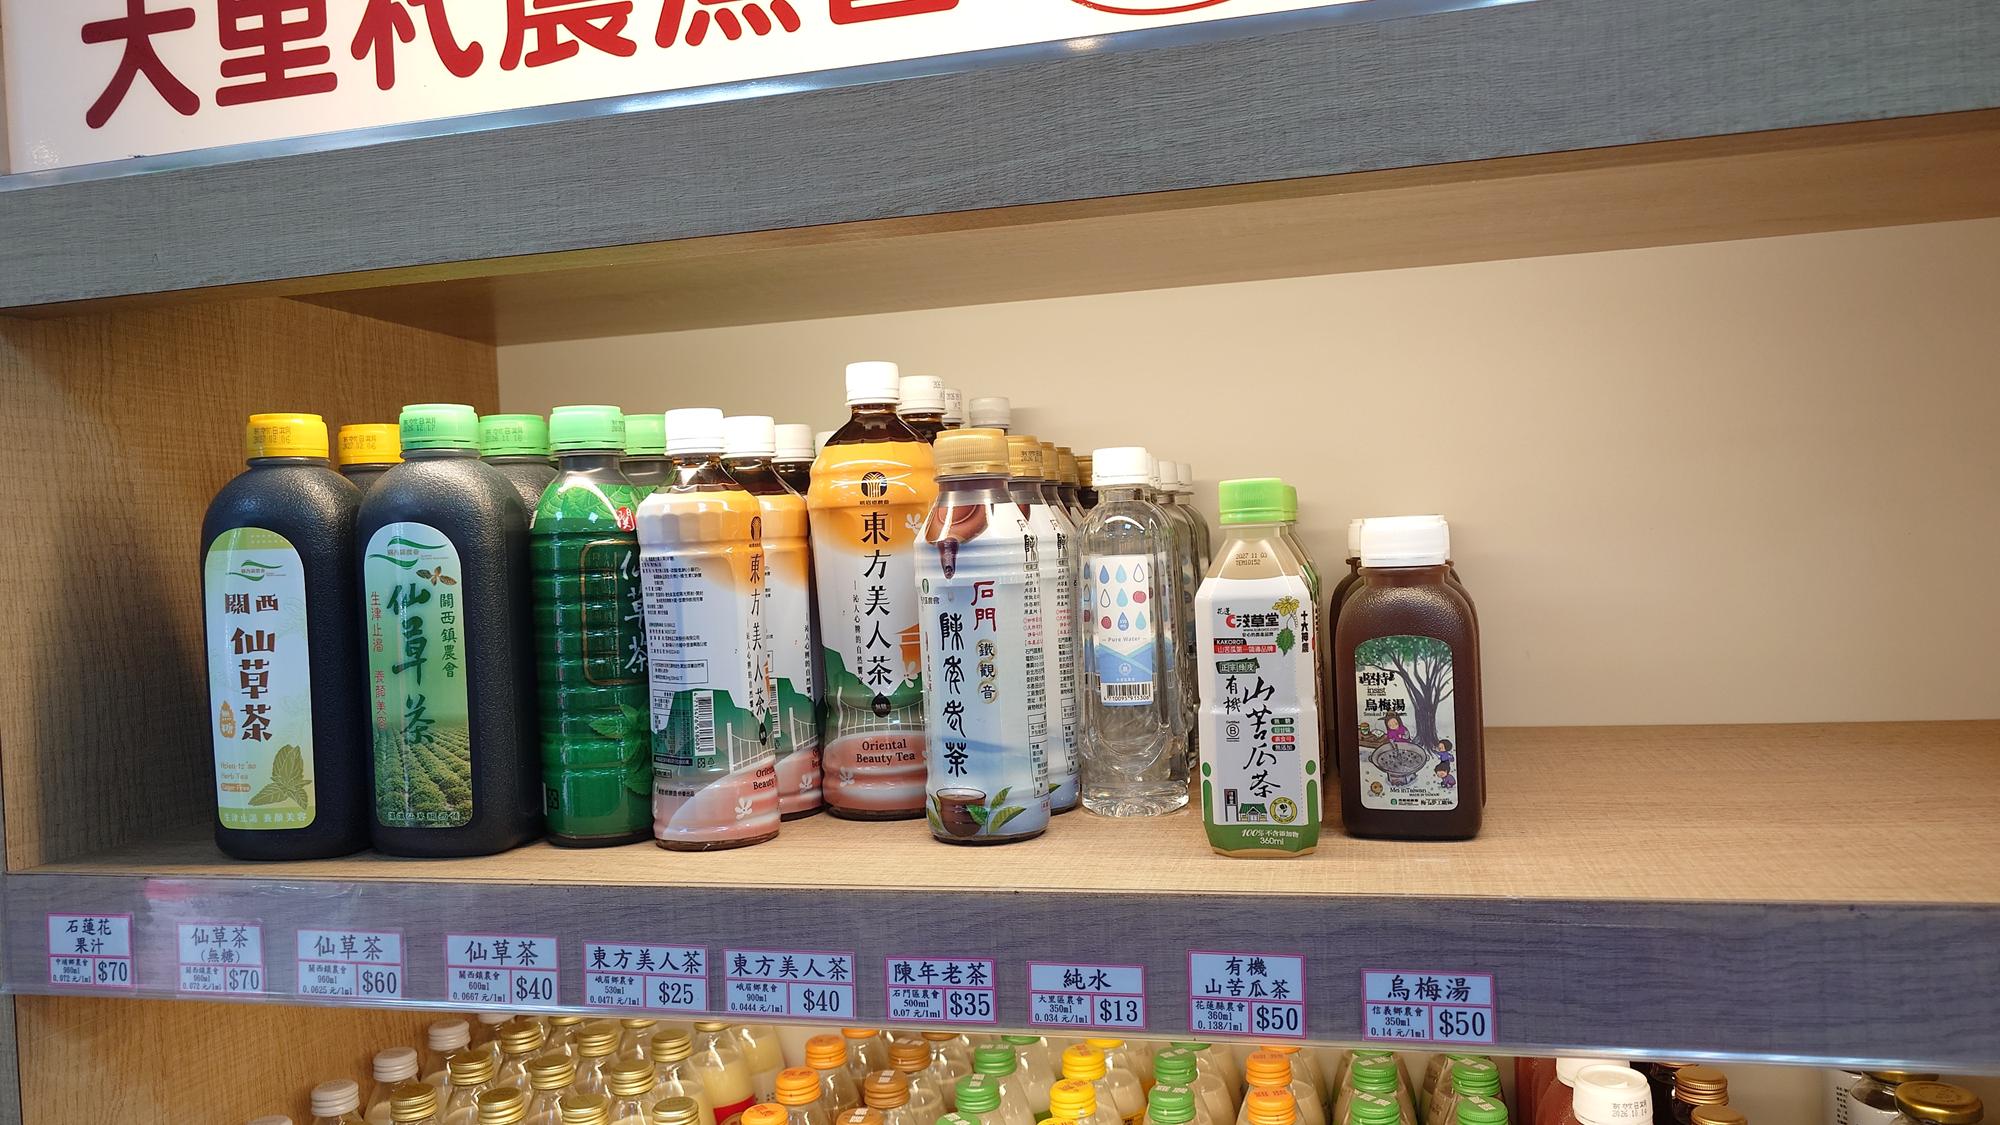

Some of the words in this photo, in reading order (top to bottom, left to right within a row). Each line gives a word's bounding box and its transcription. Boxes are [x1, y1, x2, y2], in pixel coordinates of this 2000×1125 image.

[225, 593, 279, 615] 關西
[861, 512, 893, 686] 東方美人茶
[971, 580, 996, 632] 石門
[371, 591, 383, 653] 生津止渴
[440, 593, 458, 678] 關西鎮農會
[750, 554, 766, 716] 東方美人茶
[387, 583, 435, 745] 仙草茶
[978, 643, 997, 700] 鐵觀音
[231, 627, 275, 742] 仙草茶
[940, 612, 969, 778] 陳年老茶
[1224, 675, 1242, 715] 有機
[1365, 698, 1406, 711] 烏梅湯
[862, 738, 907, 751] Oriental
[1243, 677, 1280, 798] 山苦瓜茶
[856, 752, 892, 766] Beauty
[896, 752, 916, 763] Tea
[756, 767, 775, 778] Orien
[66, 919, 112, 935] 石蓮花
[192, 926, 249, 949] 仙草茶
[75, 938, 104, 953] 果汁
[200, 949, 240, 964] (無糖)
[314, 934, 383, 961] 仙草茶
[465, 940, 539, 967] 仙草茶
[98, 961, 127, 982] $70
[590, 946, 703, 975] 東方美人茶
[730, 953, 849, 981] 東方美人茶
[1225, 956, 1268, 978] 有機
[229, 968, 260, 990] $70
[362, 970, 397, 994] $60
[894, 961, 988, 986] 陳年老茶
[1062, 968, 1112, 991] 純水
[468, 981, 489, 991] 600ml
[516, 976, 552, 1001] $40
[604, 986, 625, 995] 530ml
[658, 981, 694, 1005] $25
[892, 989, 940, 999] 石門區農會
[1205, 978, 1291, 999] 山苦瓜茶
[1387, 975, 1472, 1001] 烏梅湯
[746, 993, 767, 1003] 900ml
[803, 988, 839, 1013] $40
[904, 999, 929, 1008] 500ml
[950, 992, 990, 1017] $35
[1038, 994, 1085, 1005] 大里區農會
[1049, 1004, 1072, 1014] 350ml
[1195, 1000, 1245, 1013] 花蓮縣農會
[893, 1008, 910, 1017] 0.07
[1034, 1013, 1058, 1023] 0.034
[1099, 998, 1138, 1023] $13
[1207, 1011, 1233, 1021] 360ml
[1256, 1006, 1298, 1032] $50
[1372, 1006, 1423, 1017] 信義鄉農會
[1384, 1017, 1410, 1027] 350ml
[1370, 1027, 1392, 1037] 0.14
[1439, 1009, 1486, 1037] $50
